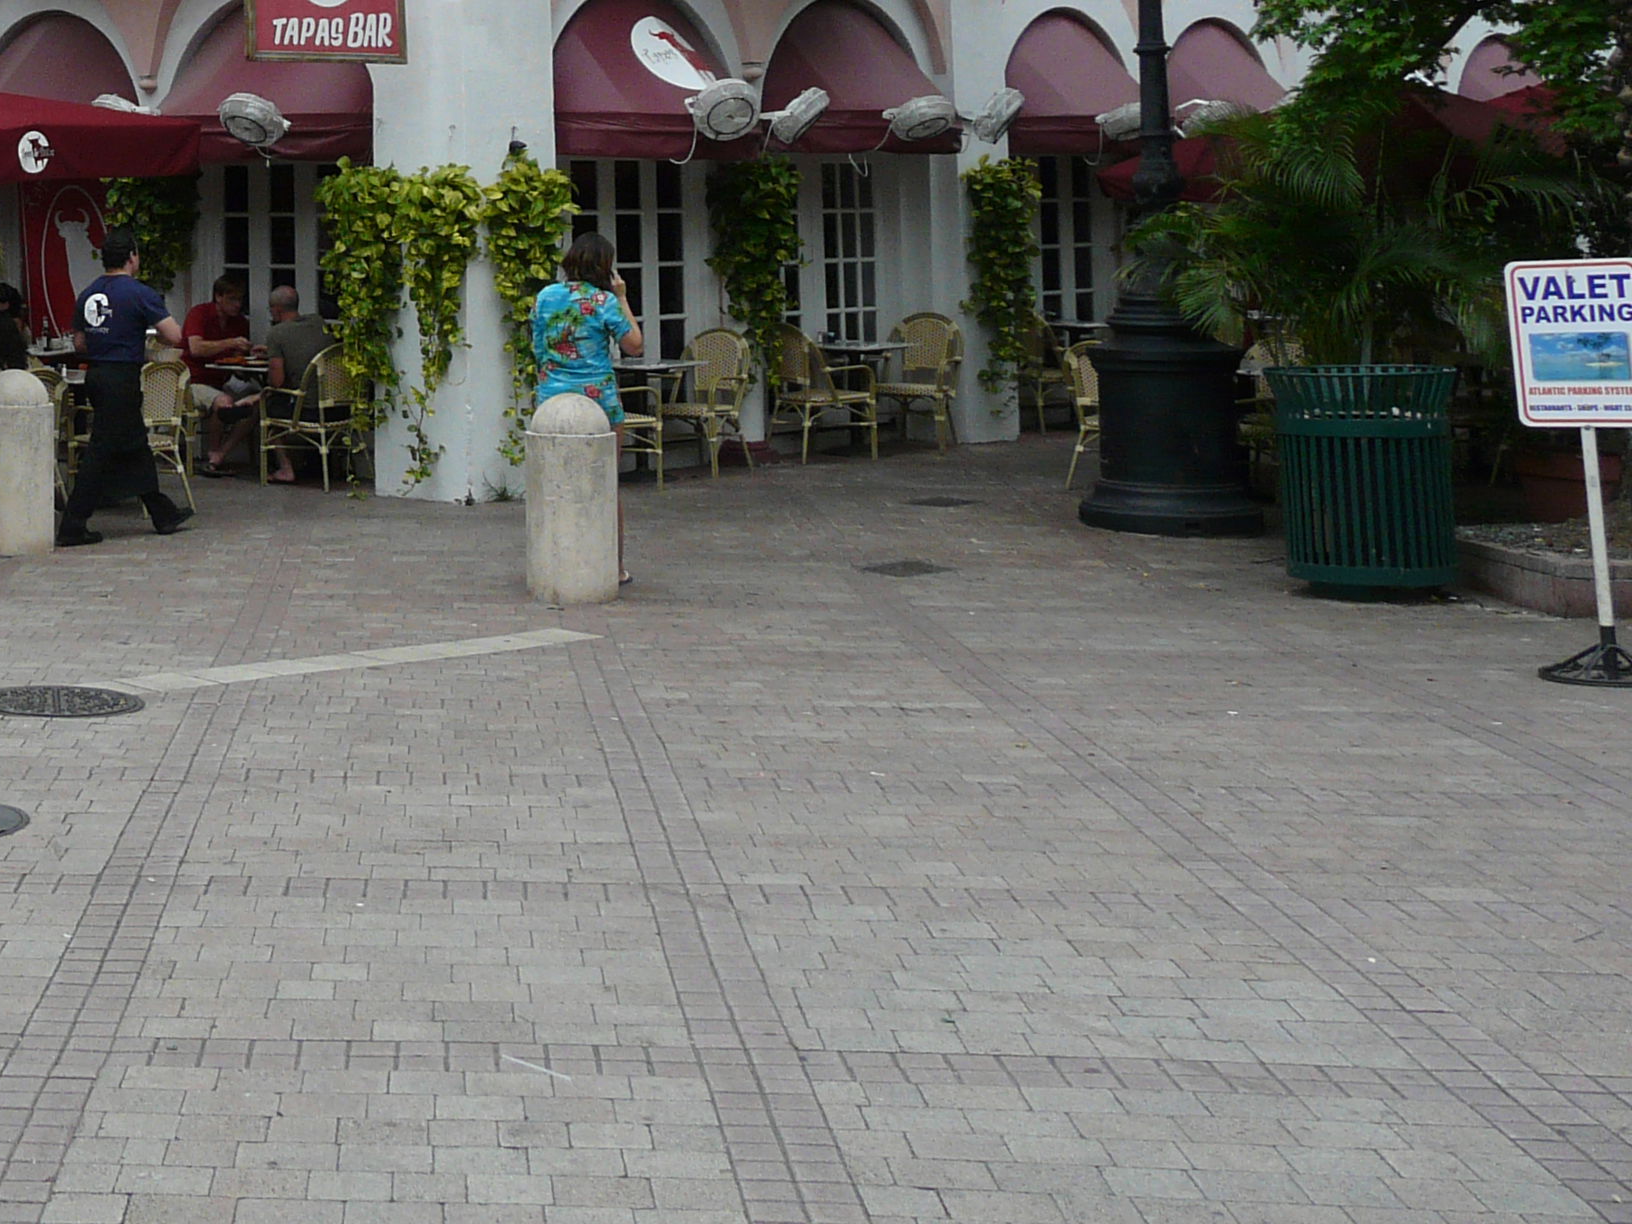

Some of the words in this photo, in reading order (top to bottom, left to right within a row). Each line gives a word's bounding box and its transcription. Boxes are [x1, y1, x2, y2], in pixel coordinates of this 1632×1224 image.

[272, 16, 344, 47] TAPAS
[346, 12, 394, 48] BAR
[1517, 273, 1631, 301] VALET
[1520, 303, 1632, 324] PARKING
[1529, 386, 1566, 396] ATLANTIC
[1567, 386, 1603, 396] PARKING
